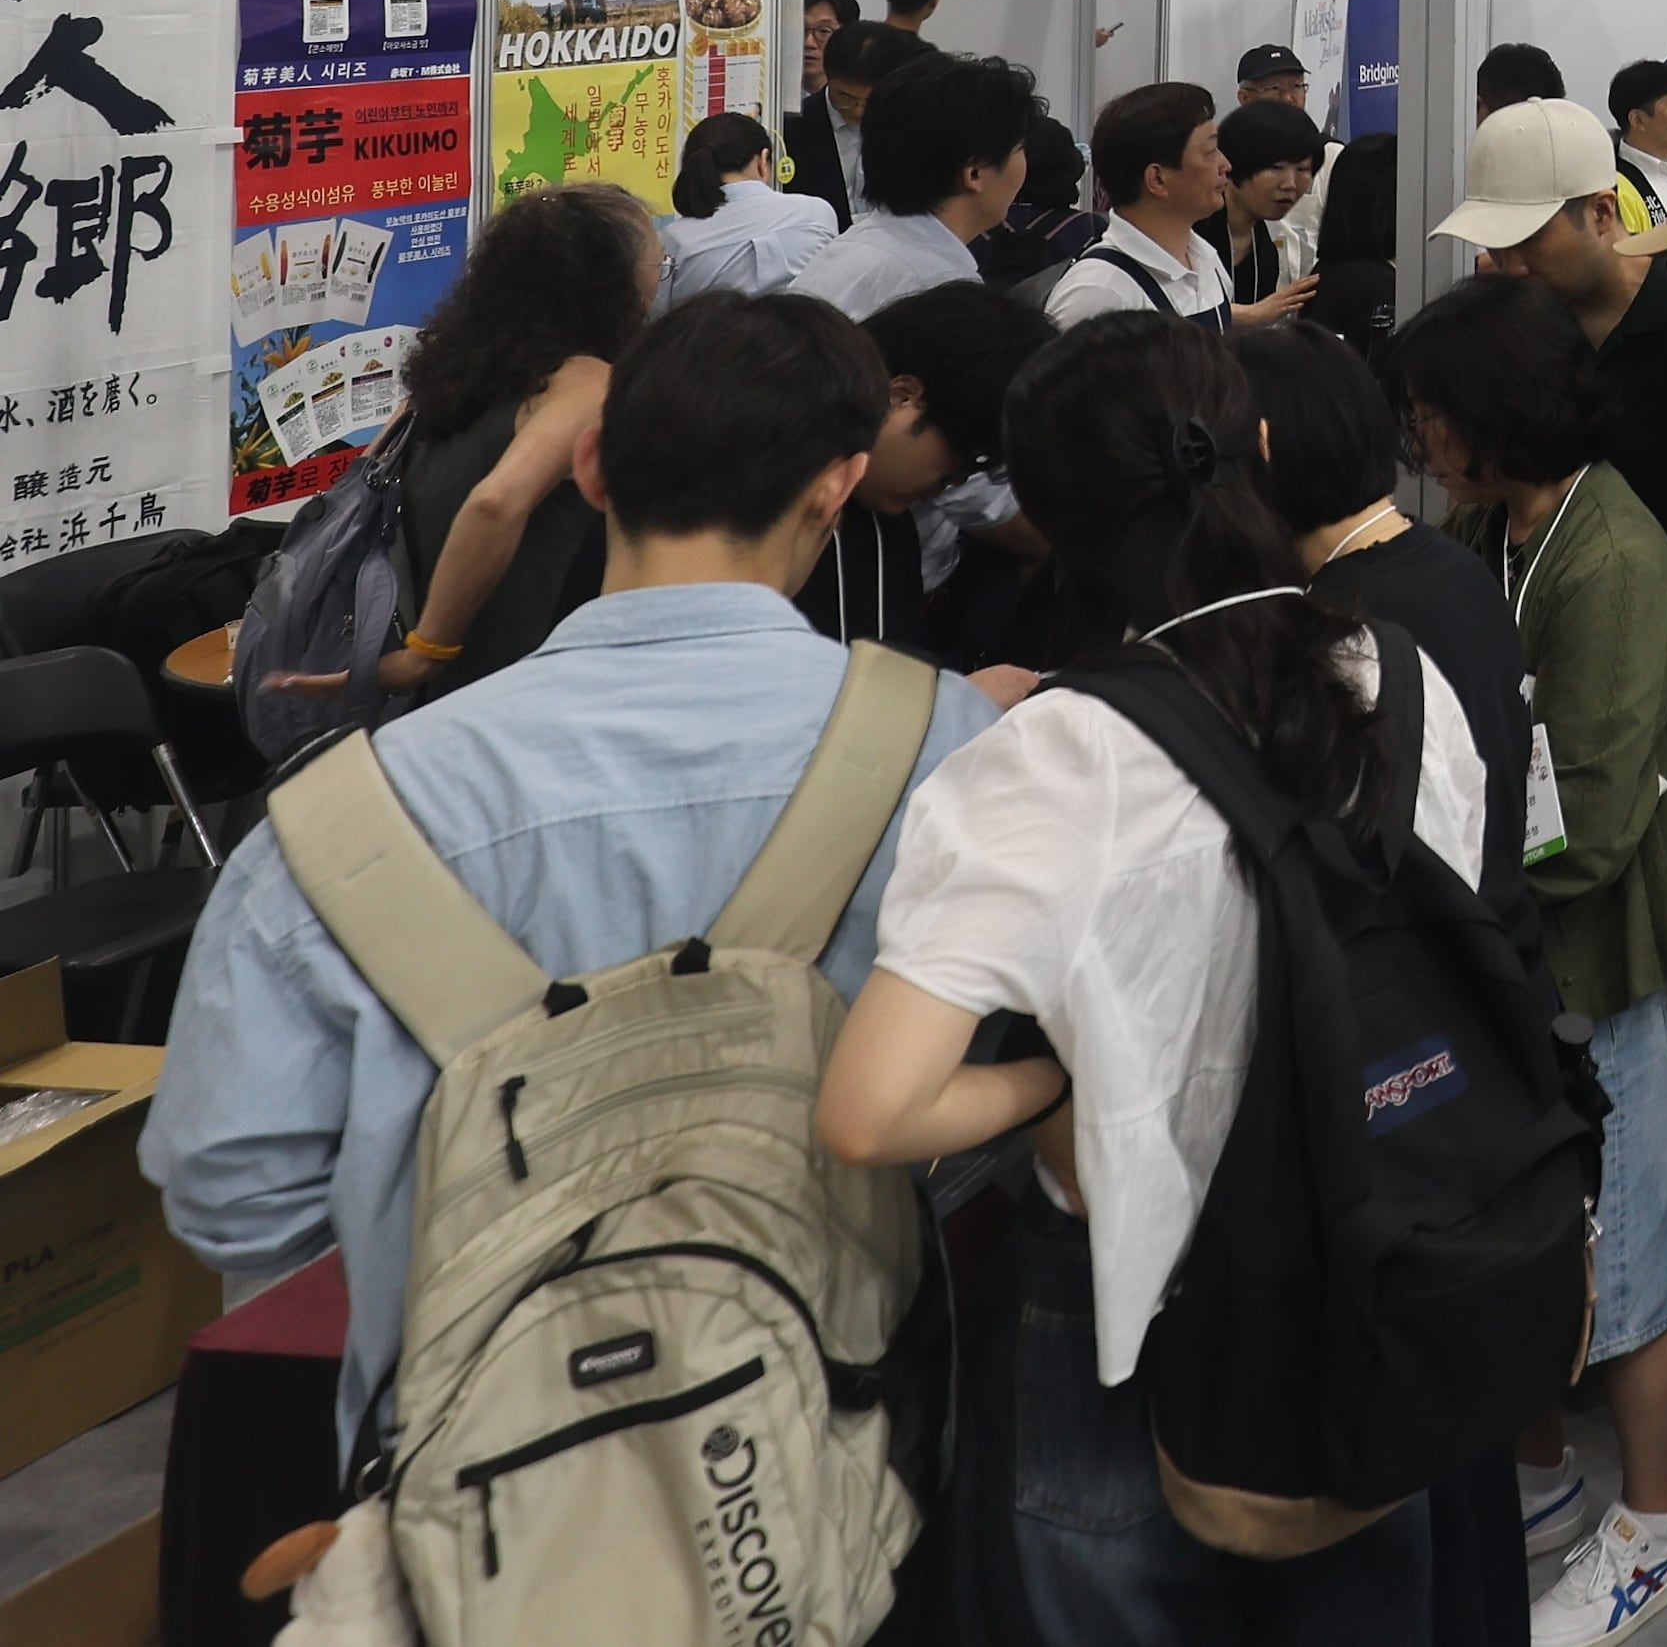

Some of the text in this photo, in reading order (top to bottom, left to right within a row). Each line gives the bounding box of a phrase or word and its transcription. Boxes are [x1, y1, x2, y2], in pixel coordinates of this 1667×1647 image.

[321, 61, 368, 80] 시리즈
[498, 23, 677, 69] HOKKAIDO
[242, 107, 343, 170] 菊芋
[354, 129, 458, 160] KIKUIMO
[561, 103, 577, 173] 세계로
[632, 92, 648, 160] 무농약
[655, 66, 671, 179] 홋카이도산
[249, 171, 459, 214] 수용성식이섬유 풍부한 이눌린
[704, 1434, 794, 1647] Discover
